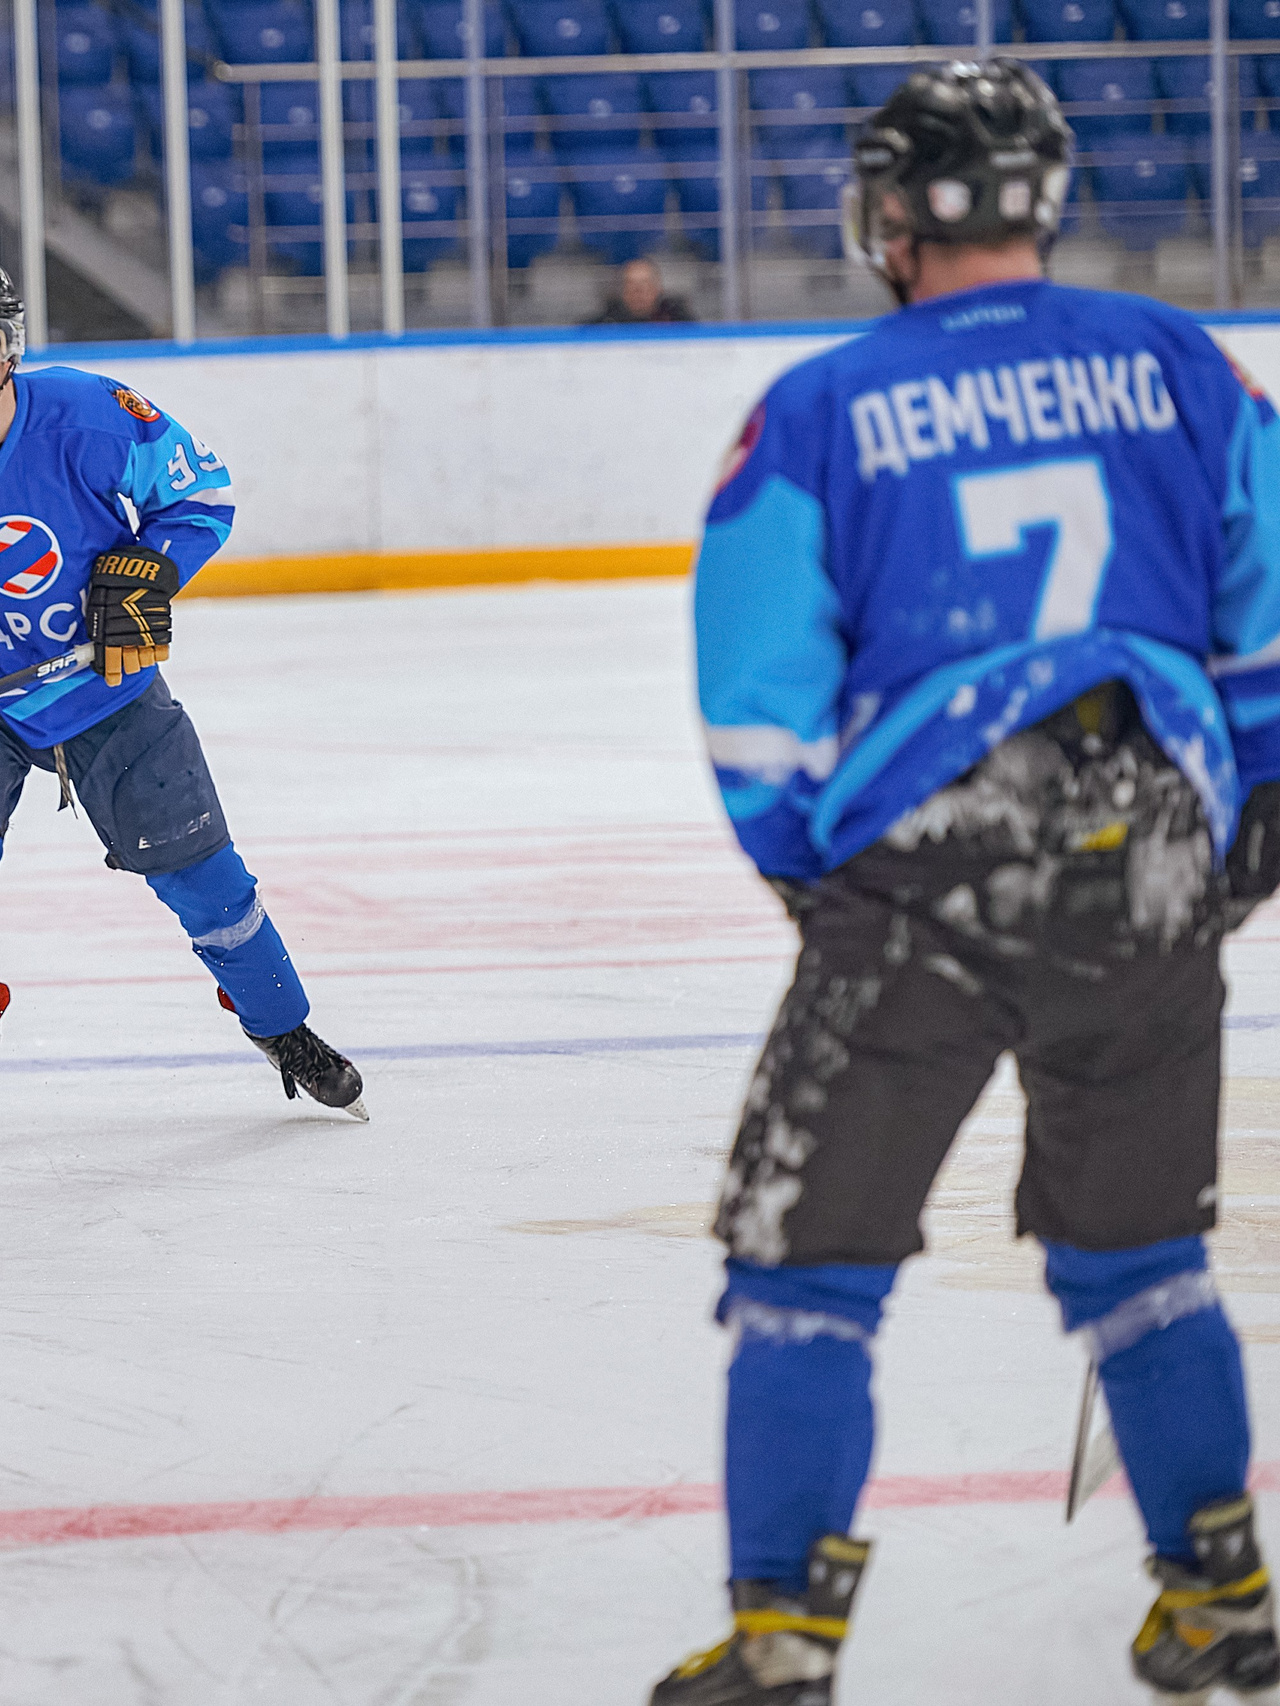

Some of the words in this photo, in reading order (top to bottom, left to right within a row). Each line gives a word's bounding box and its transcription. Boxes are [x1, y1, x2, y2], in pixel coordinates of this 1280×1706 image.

[851, 352, 1177, 478] ДЕМЧЕНКО
[96, 555, 161, 582] RRIOR
[950, 455, 1116, 645] 7
[37, 654, 76, 677] SAP
